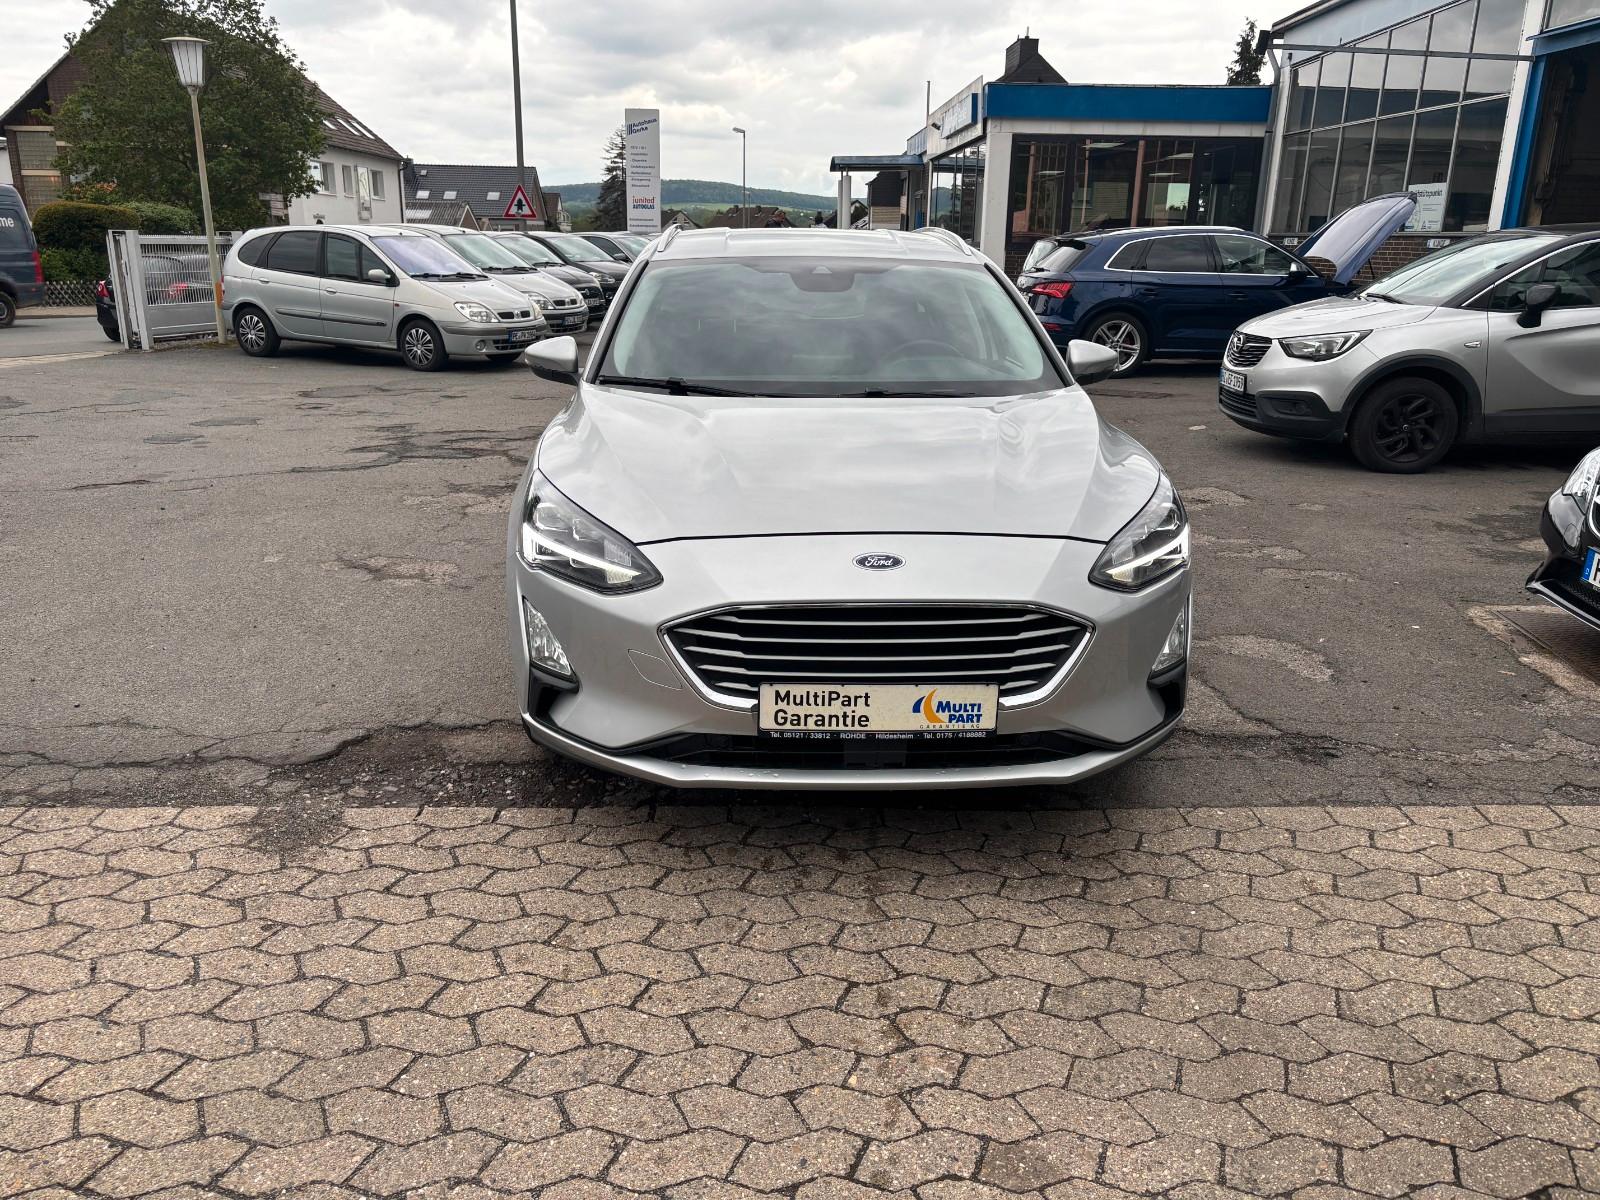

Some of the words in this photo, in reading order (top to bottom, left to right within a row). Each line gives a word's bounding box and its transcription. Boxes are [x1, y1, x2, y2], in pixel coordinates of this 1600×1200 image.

[632, 118, 657, 128] Autohaus
[865, 556, 893, 566] Ford
[774, 689, 871, 707] MultiPart
[935, 700, 982, 713] MULTI
[773, 709, 870, 728] Garantie
[947, 713, 983, 724] PART
